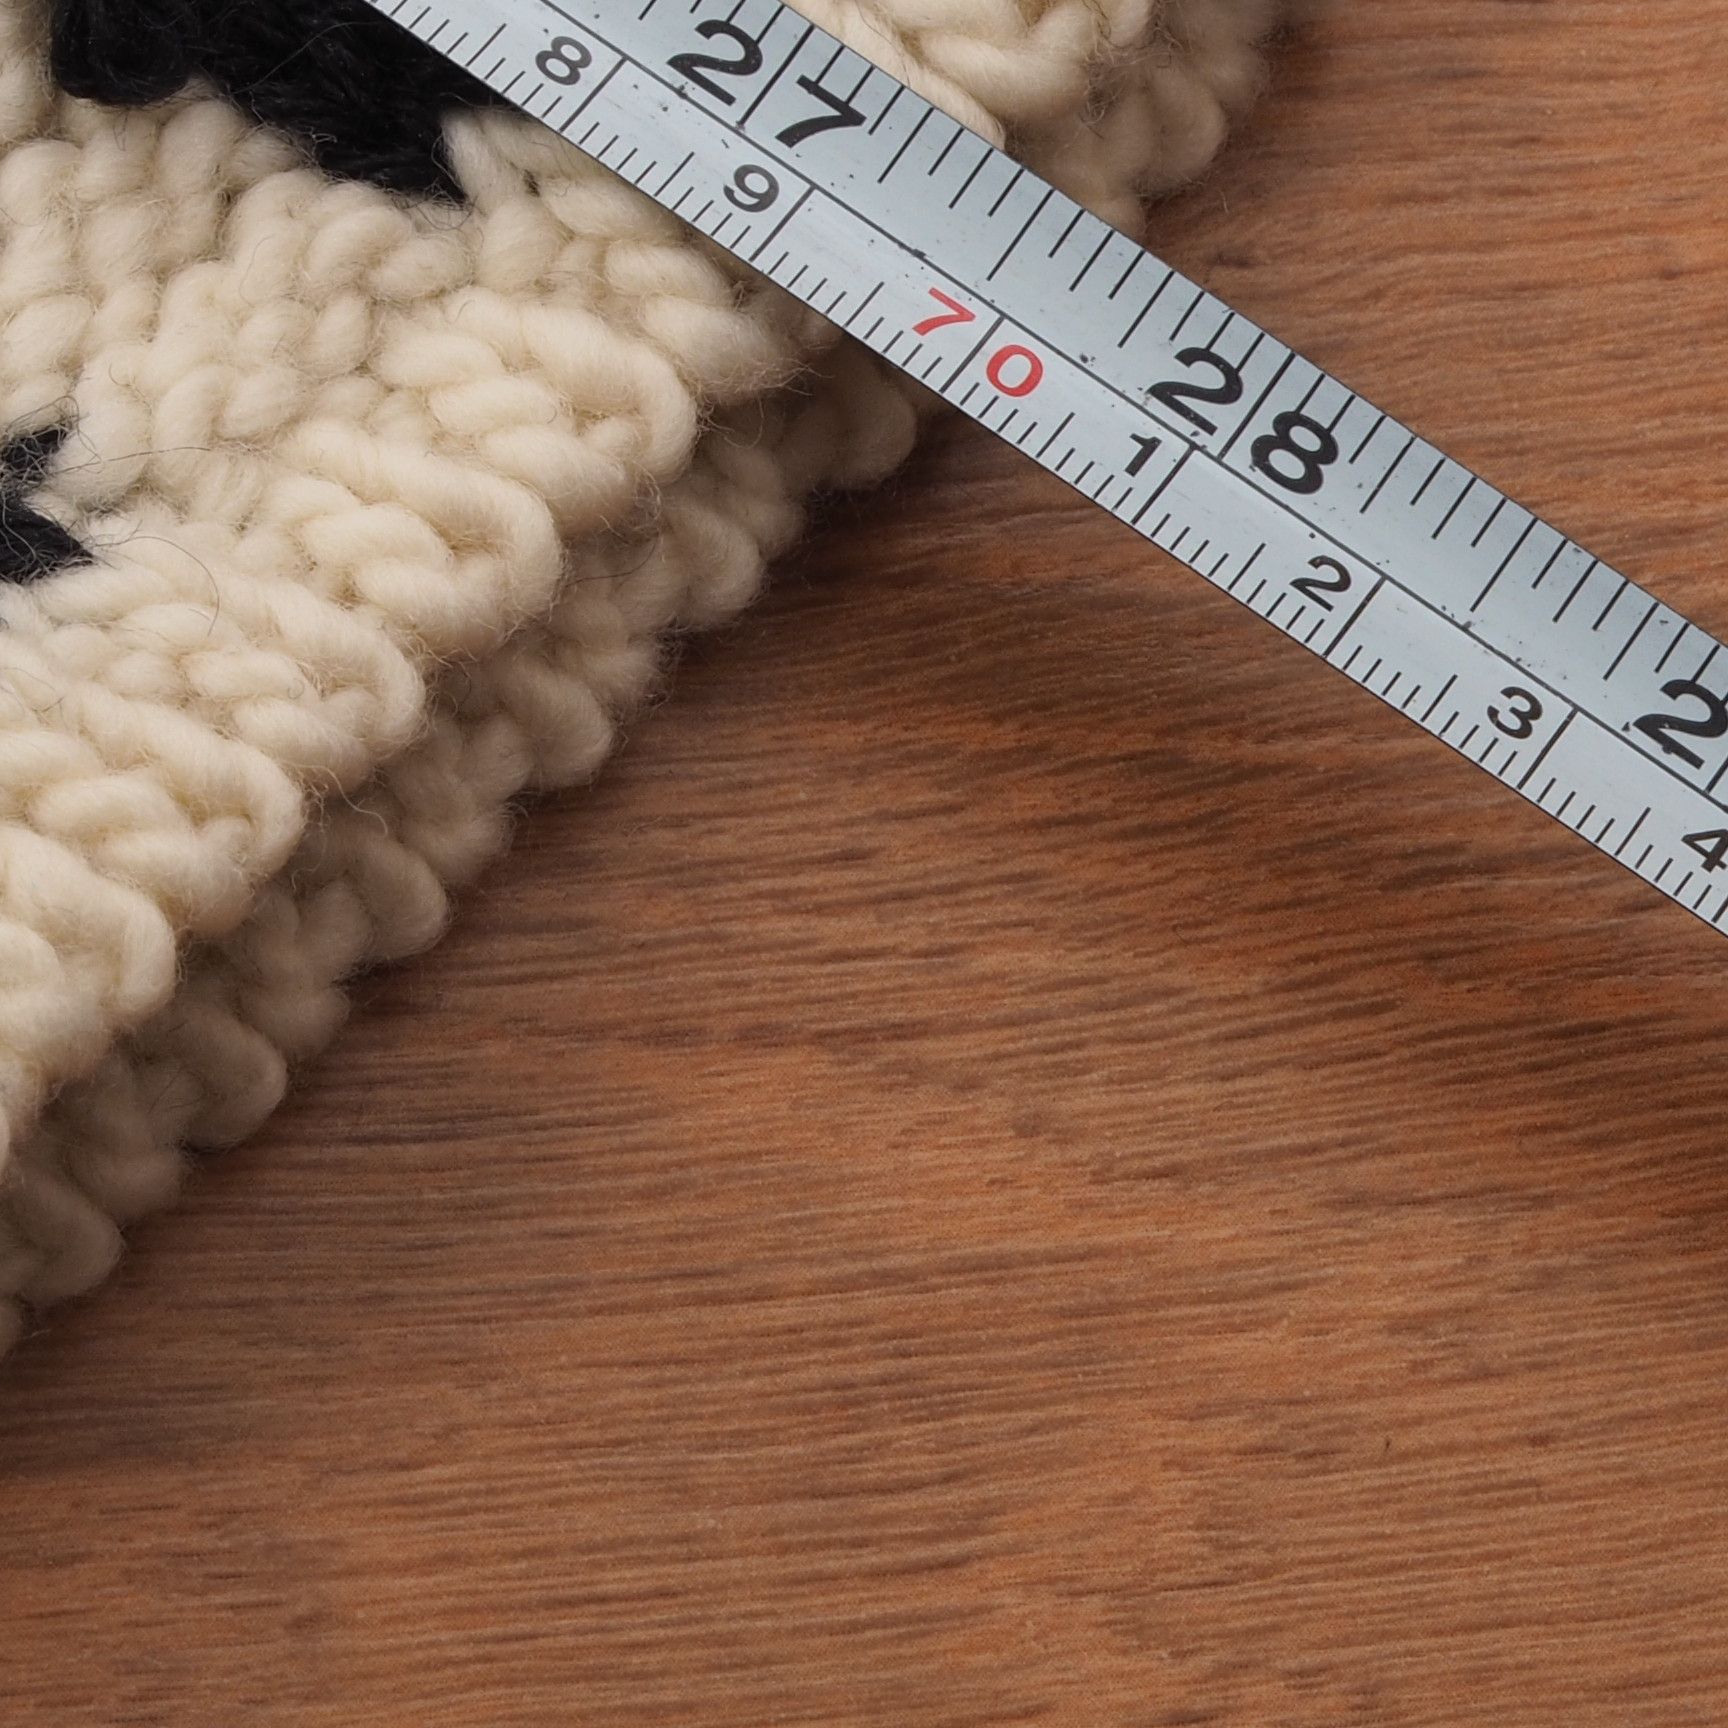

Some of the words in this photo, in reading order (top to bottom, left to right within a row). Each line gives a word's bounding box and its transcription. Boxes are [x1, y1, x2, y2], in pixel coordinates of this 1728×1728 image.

[535, 35, 593, 86] 8
[665, 19, 867, 148] 27
[722, 163, 780, 213] 9
[910, 287, 1044, 397] 70
[1145, 346, 1339, 495] 28
[1123, 433, 1161, 476] 1
[1289, 554, 1352, 612] 2
[1486, 686, 1543, 740] 3
